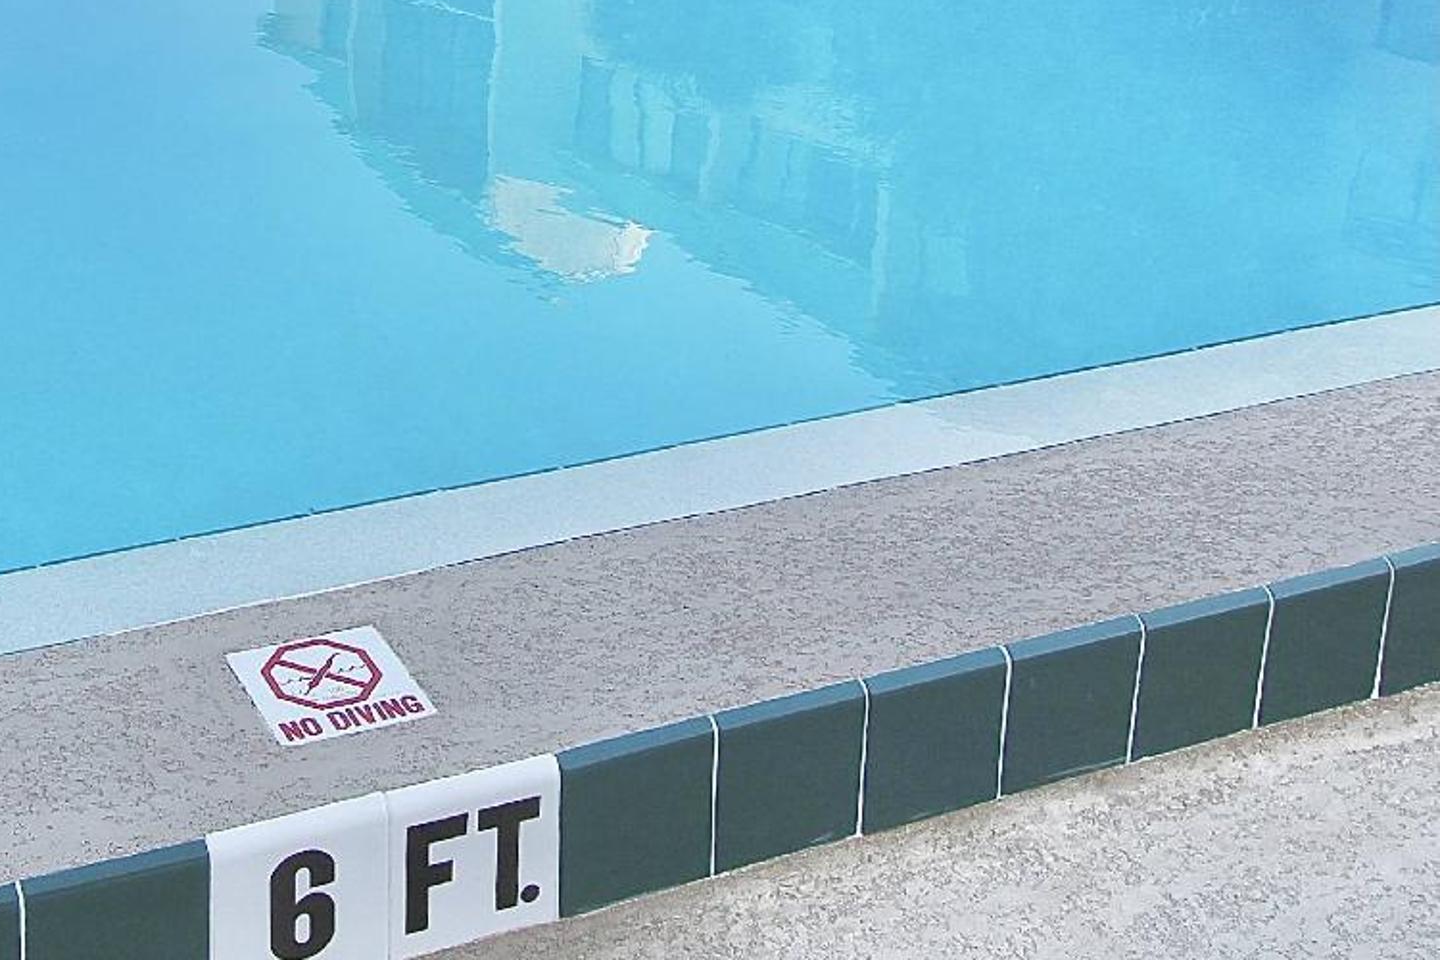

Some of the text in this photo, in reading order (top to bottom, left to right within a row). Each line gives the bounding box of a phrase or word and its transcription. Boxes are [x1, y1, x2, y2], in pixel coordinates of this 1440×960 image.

[278, 694, 426, 742] NO DIVING
[270, 795, 541, 960] 6 FT.
